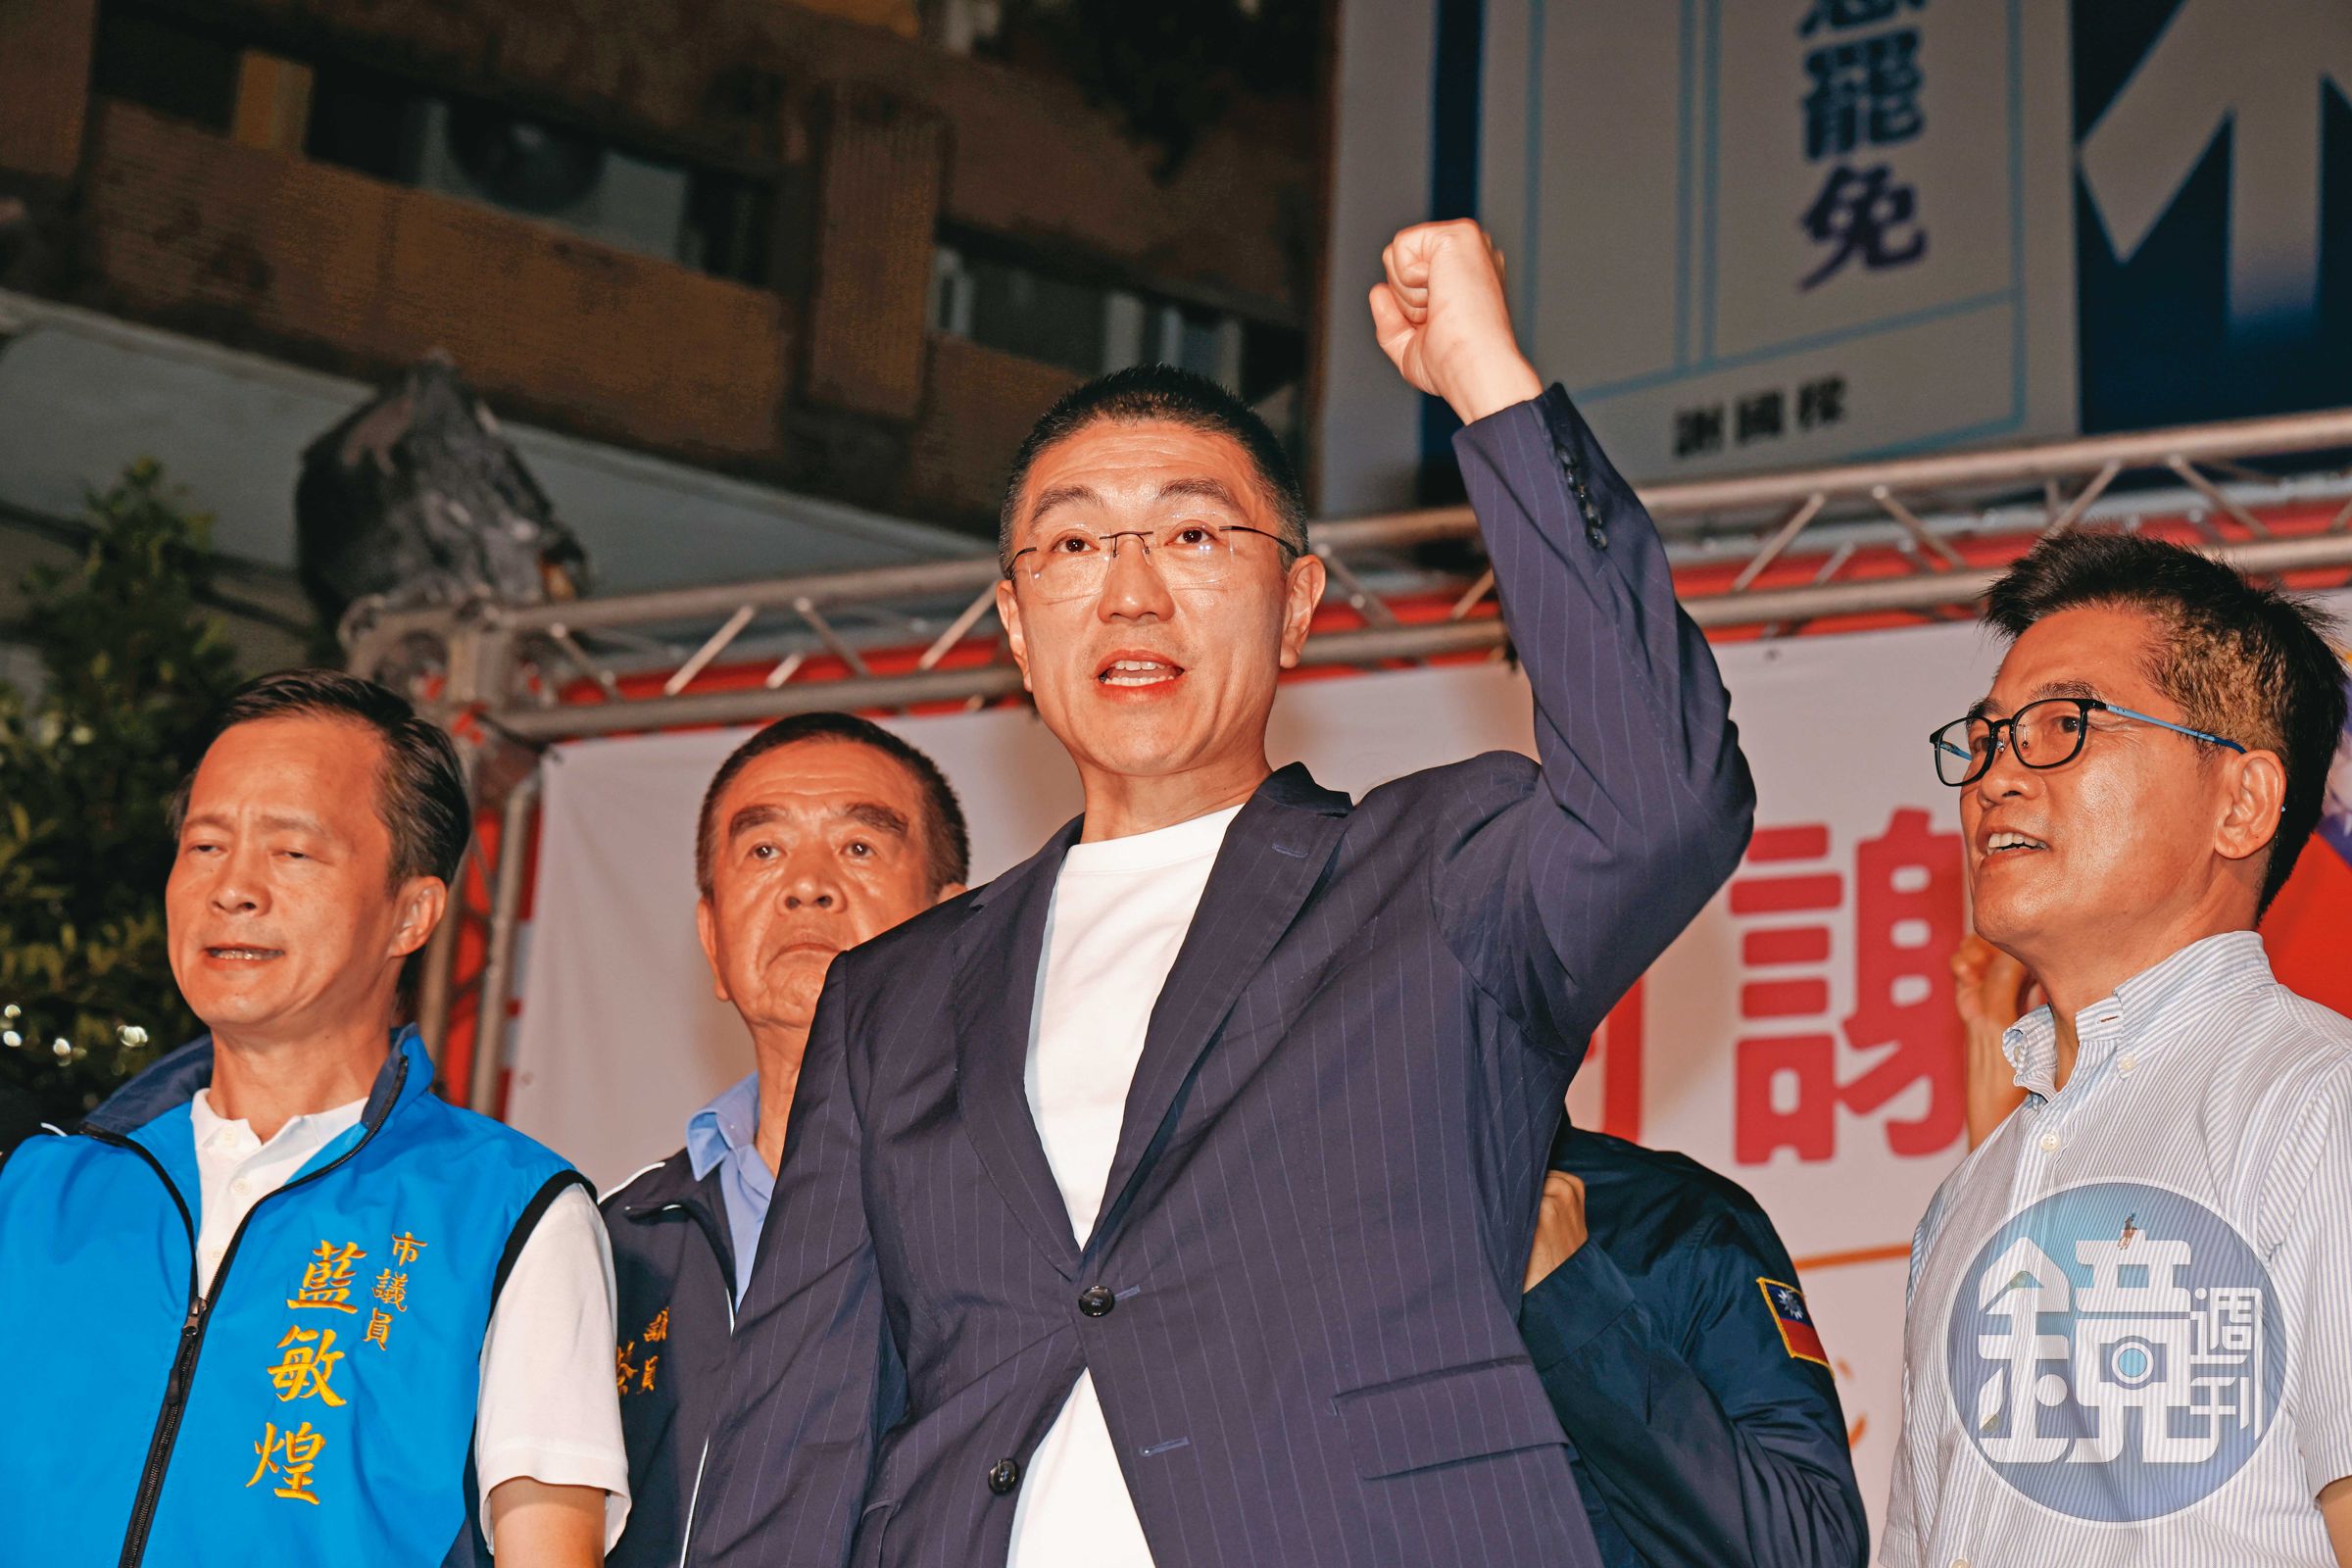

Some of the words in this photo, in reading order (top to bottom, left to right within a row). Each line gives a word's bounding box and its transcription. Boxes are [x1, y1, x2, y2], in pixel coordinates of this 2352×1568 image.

[245, 1239, 368, 1505] 藍敏煌
[363, 1232, 427, 1351] 市議員
